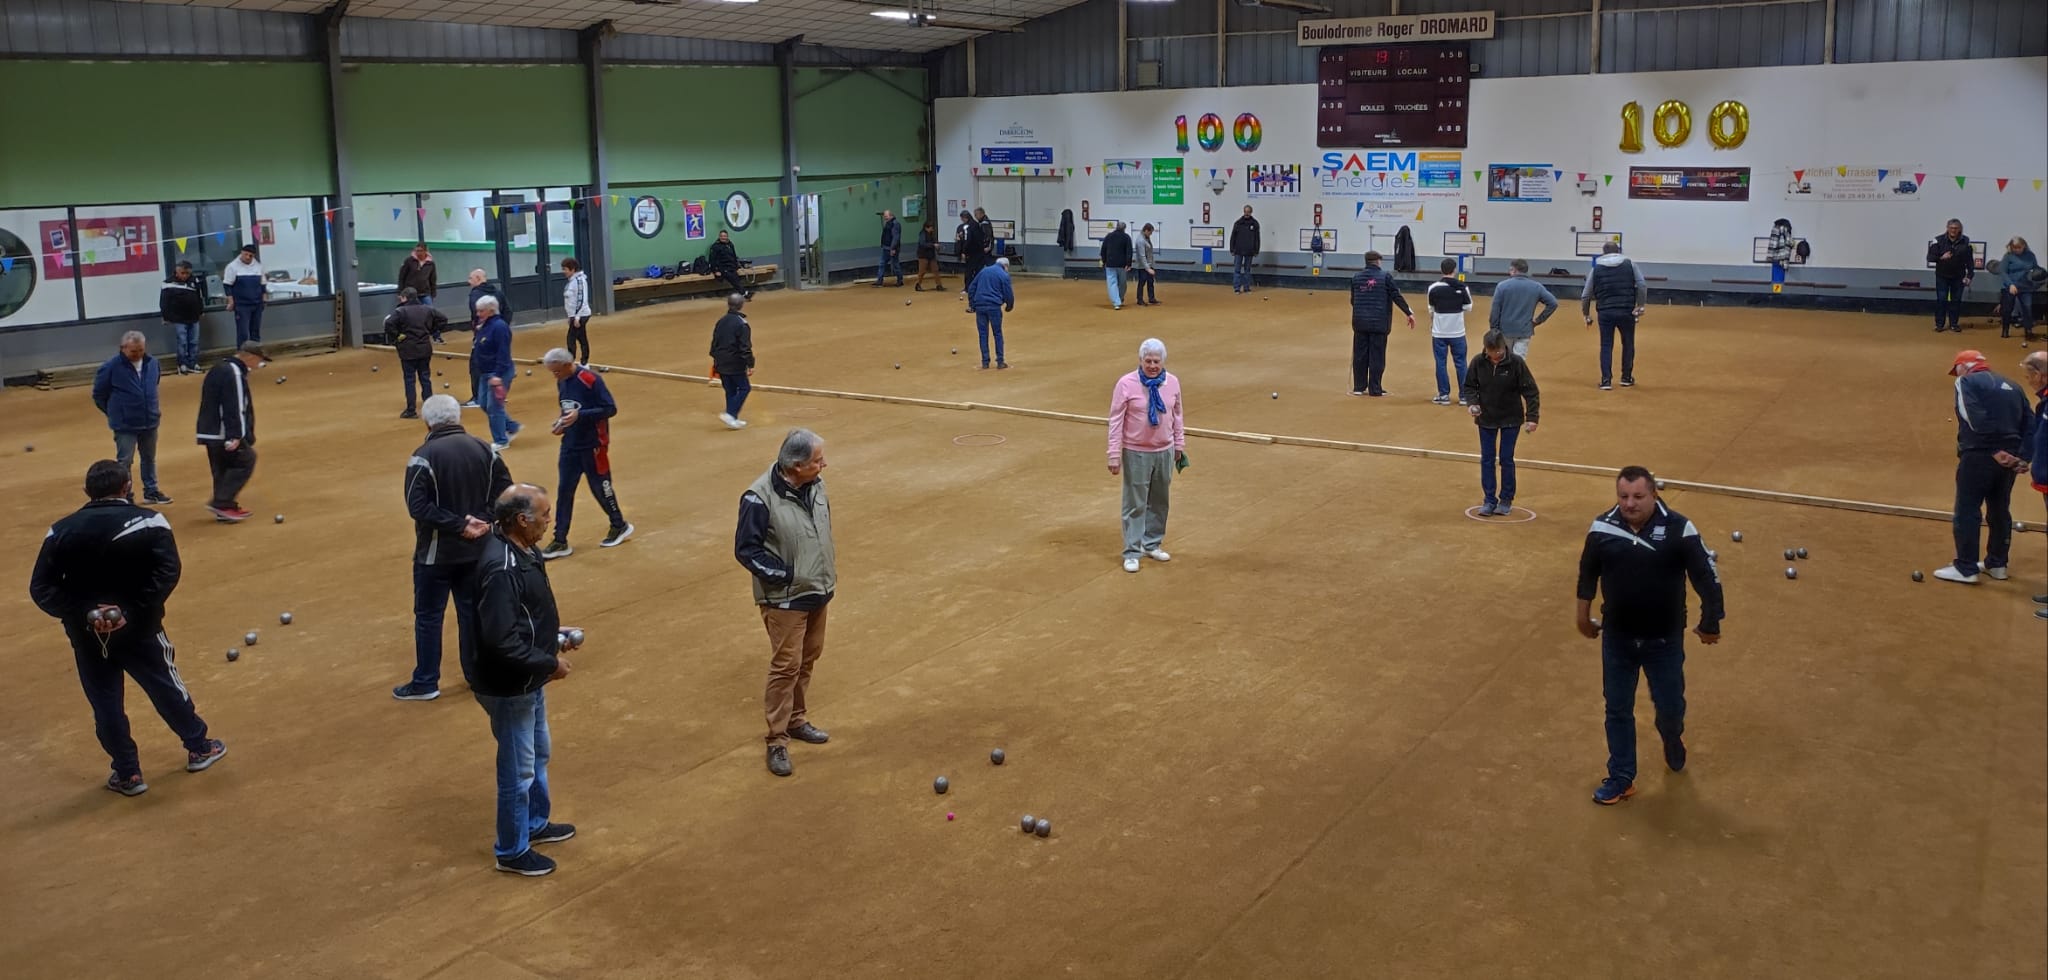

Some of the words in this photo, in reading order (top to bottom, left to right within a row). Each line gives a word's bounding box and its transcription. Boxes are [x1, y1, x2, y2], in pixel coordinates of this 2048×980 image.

[1302, 23, 1372, 40] Boulodrome
[1377, 22, 1415, 39] Roger
[1420, 16, 1488, 35] DROMARD
[1619, 100, 1749, 153] 100
[1322, 152, 1417, 171] SAEM
